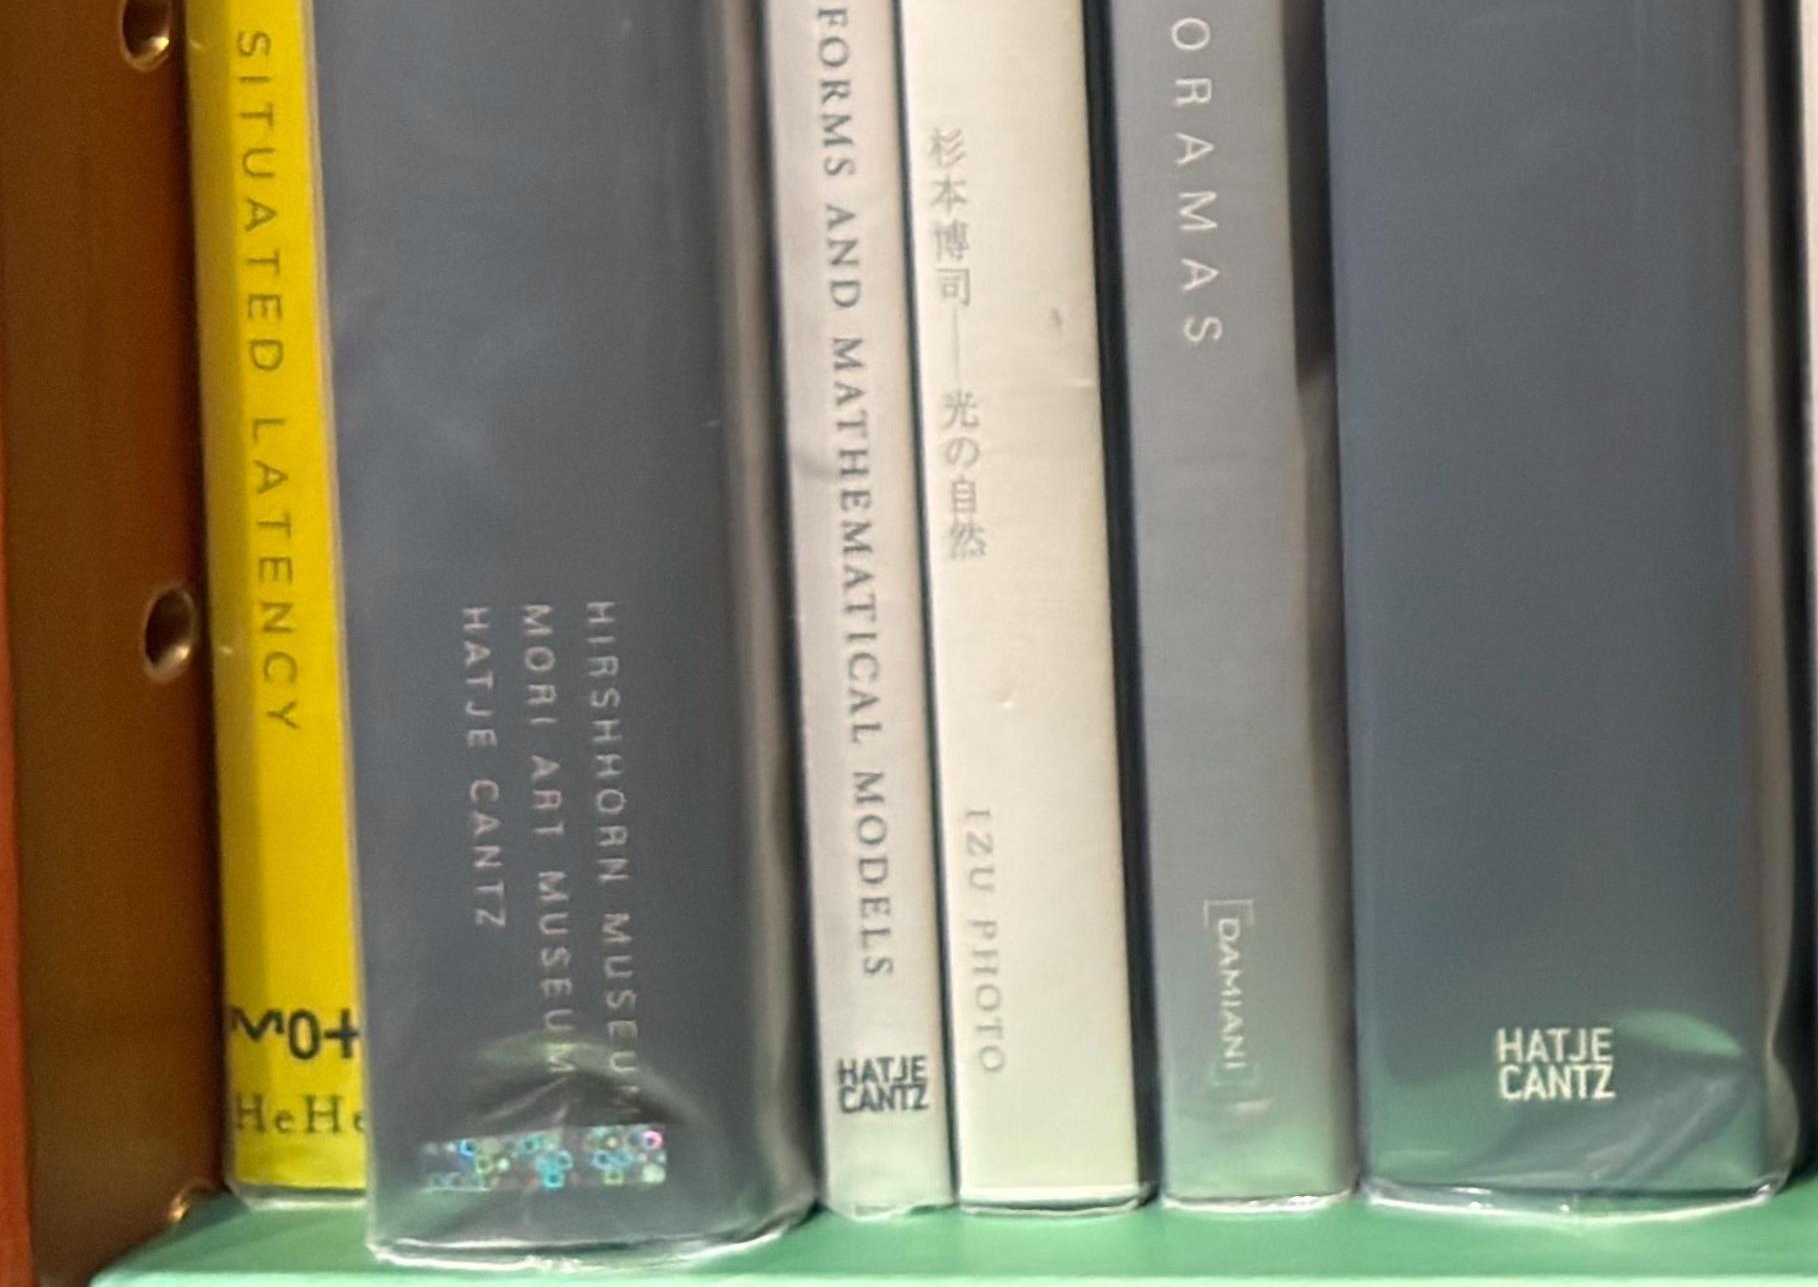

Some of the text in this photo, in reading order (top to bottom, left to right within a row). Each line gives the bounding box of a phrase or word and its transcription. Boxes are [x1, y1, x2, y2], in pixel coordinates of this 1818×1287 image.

[815, 8, 858, 179] FORMS
[823, 203, 864, 311] AND
[235, 30, 302, 733] SITUATED LATENCY
[831, 335, 884, 745] MATHEMATICAL
[462, 606, 508, 930] HATJE CANTZ
[520, 603, 577, 1074] MORI ART MUSEUM
[585, 599, 629, 882] HIRSHHORN
[850, 769, 895, 981] MODELS
[963, 806, 1005, 1074] IZU PHOTO
[836, 1054, 929, 1084] HATJE
[837, 1083, 929, 1115] CANTZ
[1496, 1027, 1613, 1065] HATJE
[1497, 1064, 1616, 1103] CANTZ
